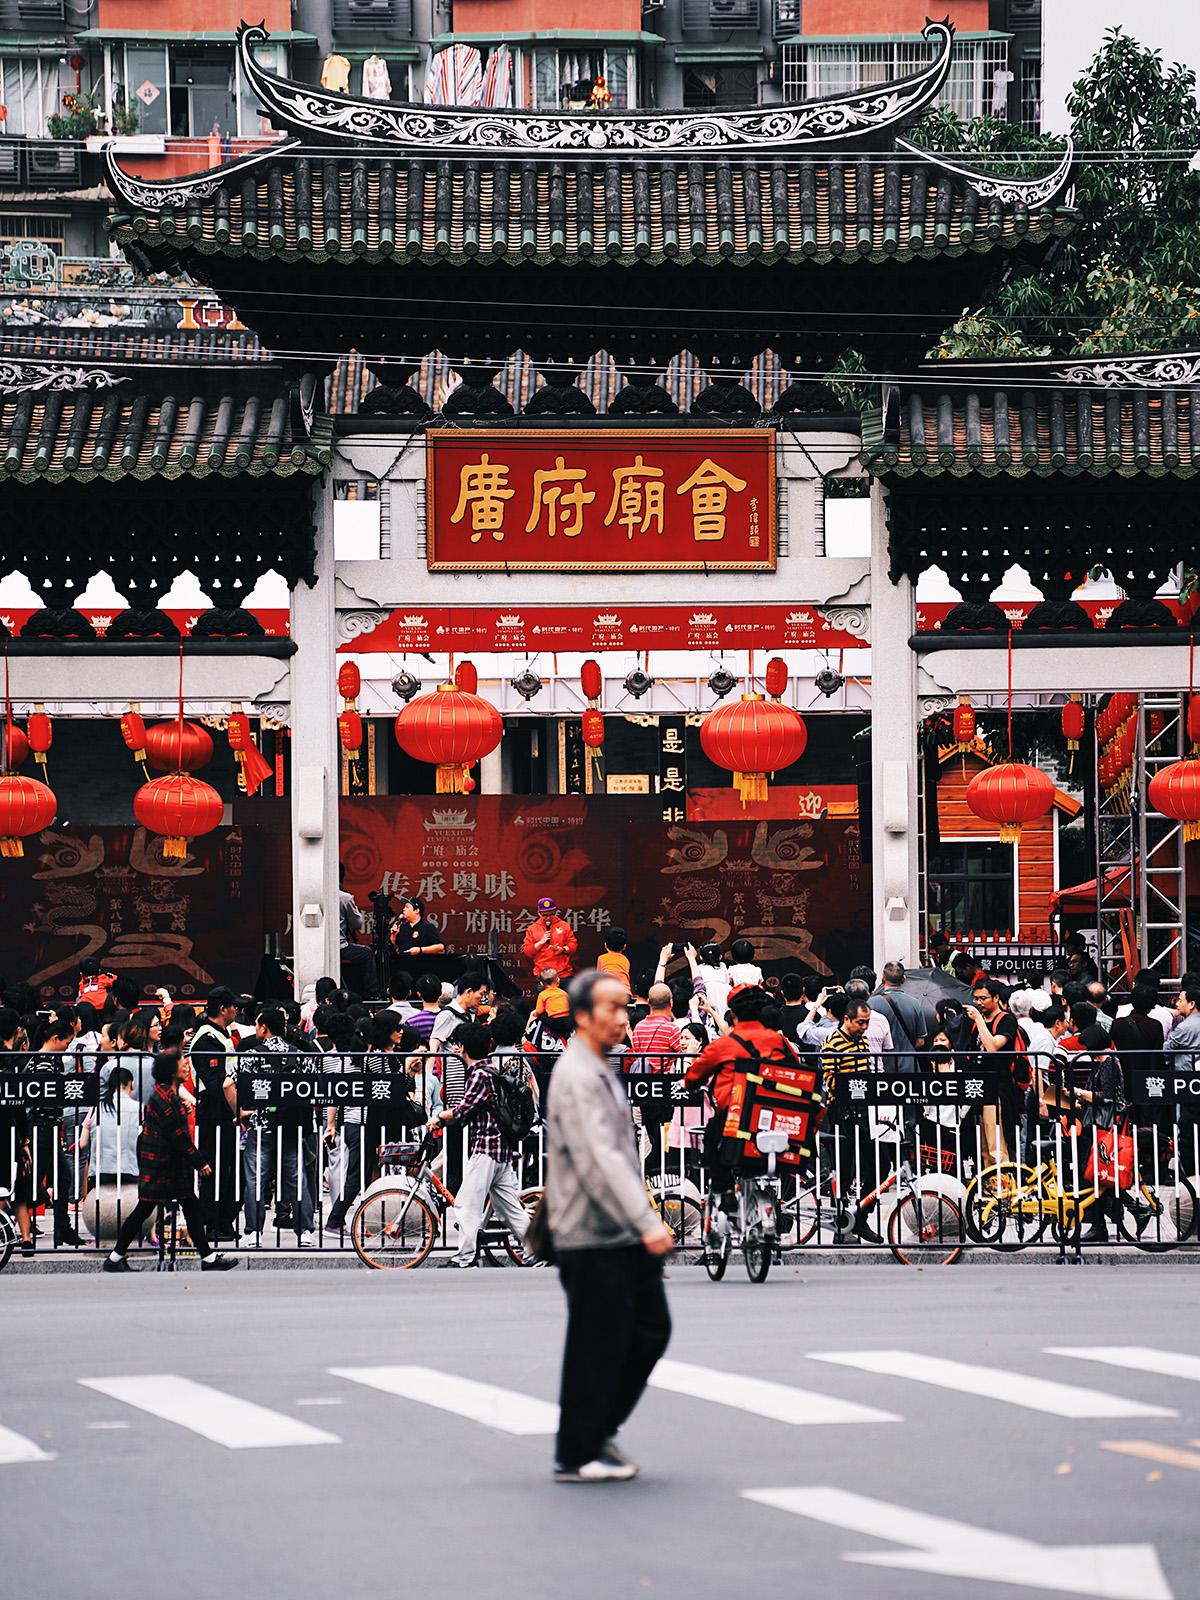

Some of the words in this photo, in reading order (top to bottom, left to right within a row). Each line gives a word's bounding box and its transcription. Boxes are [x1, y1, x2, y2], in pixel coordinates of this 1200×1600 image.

[450, 453, 748, 543] 廣府廟會
[798, 790, 823, 819] 迎
[379, 870, 517, 902] 传承粤味
[996, 960, 1043, 970] POLICE
[0, 1081, 57, 1098] LICE
[64, 1080, 85, 1100] 察
[252, 1080, 272, 1100] 警
[280, 1081, 365, 1098] POLICE
[371, 1080, 392, 1100] 察
[627, 1081, 664, 1098] ICE
[848, 1079, 868, 1100] 警
[876, 1080, 958, 1097] POLICE
[964, 1078, 985, 1099] 察
[1145, 1077, 1166, 1098] 警
